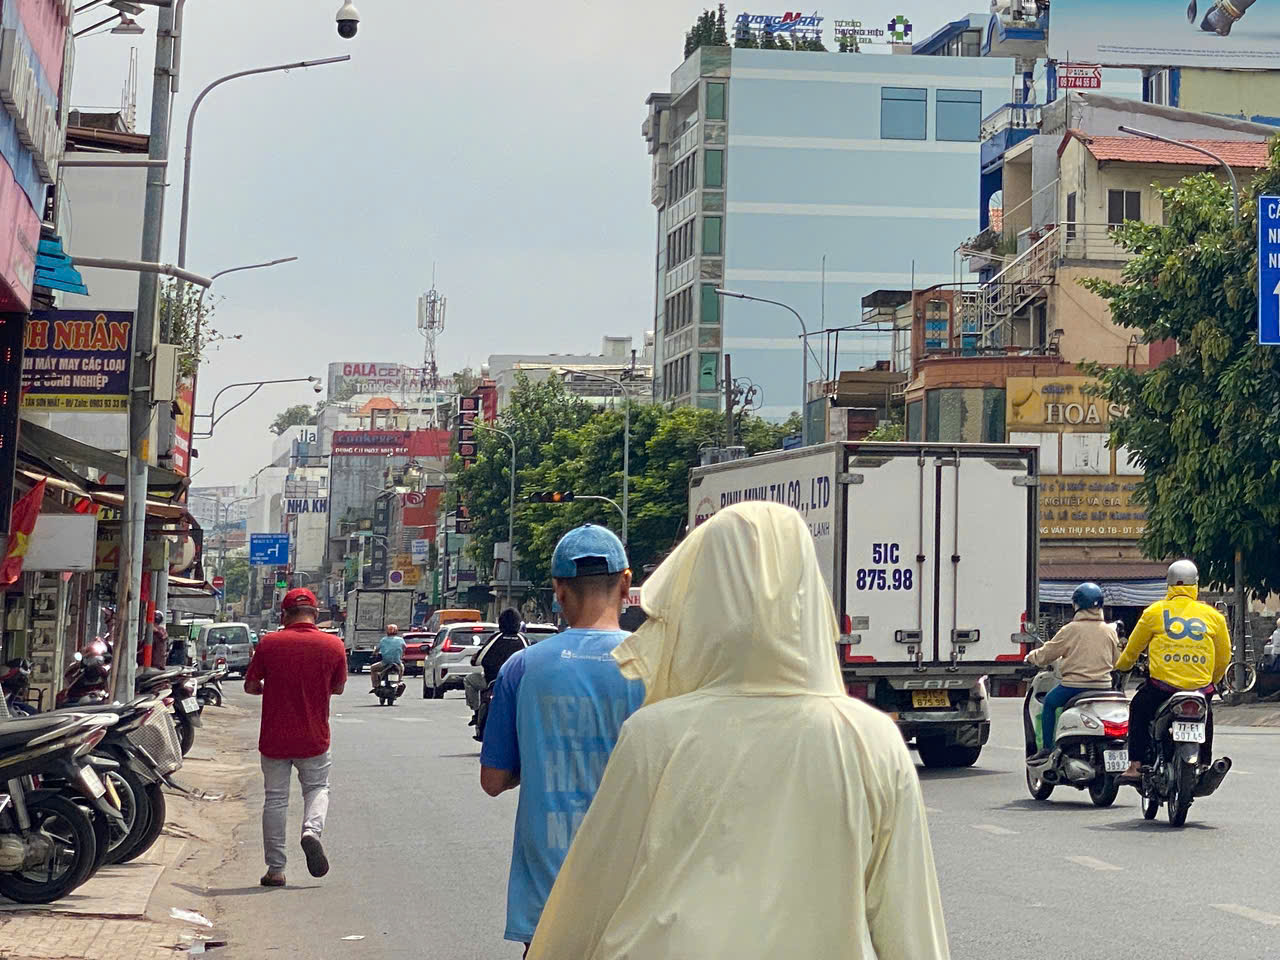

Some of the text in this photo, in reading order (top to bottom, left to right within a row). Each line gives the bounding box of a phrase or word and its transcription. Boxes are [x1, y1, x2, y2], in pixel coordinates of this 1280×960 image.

[53, 313, 130, 351] NHÂN
[35, 356, 57, 370] MÁY
[59, 359, 80, 371] MAY
[82, 356, 102, 371] CÁC
[104, 359, 125, 374] LOẠI
[343, 364, 376, 376] GALA
[73, 373, 109, 390] NGHIỆP
[1044, 402, 1101, 425] HOA
[872, 543, 899, 565] 51C
[856, 569, 913, 591] 875.98
[1163, 609, 1208, 641] be
